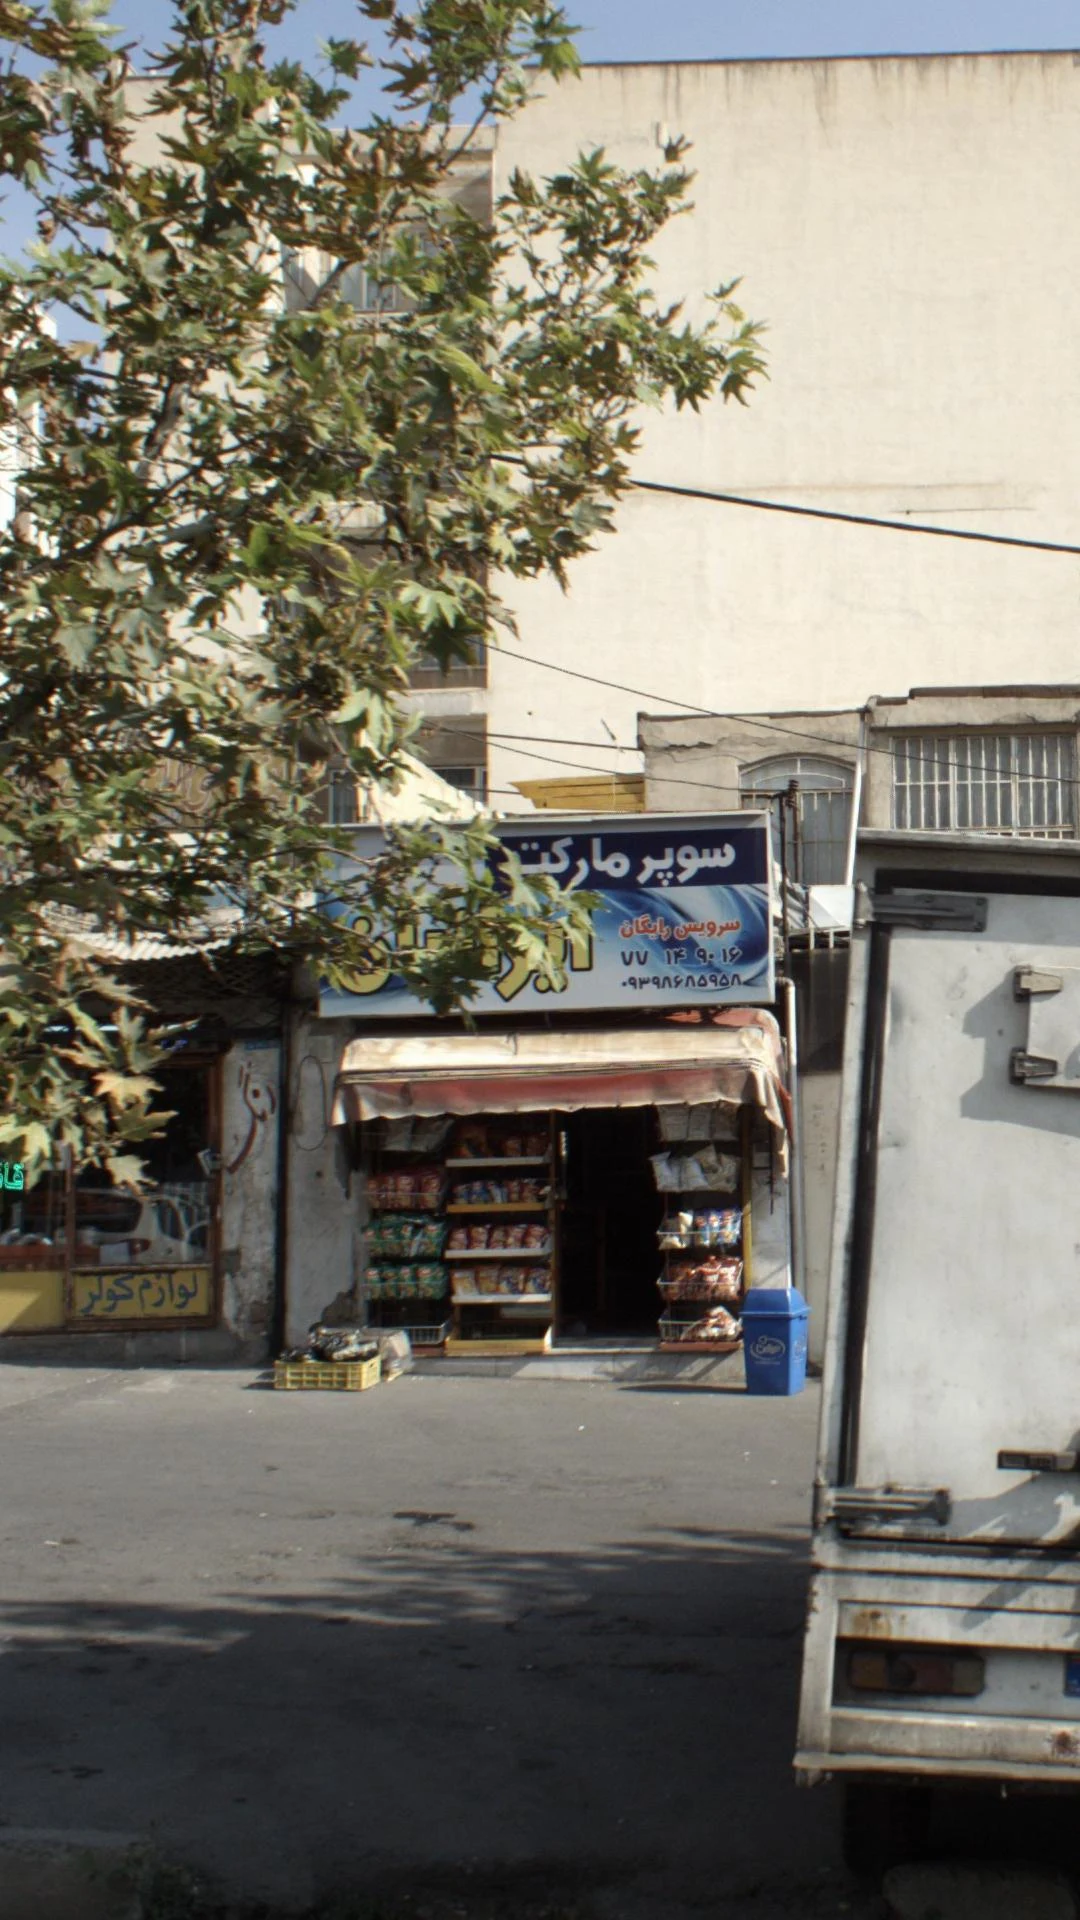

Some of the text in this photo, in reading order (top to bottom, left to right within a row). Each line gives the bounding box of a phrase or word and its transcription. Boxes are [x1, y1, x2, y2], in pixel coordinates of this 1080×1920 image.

[513, 836, 735, 891] سوپر مارکت
[620, 914, 741, 940] سرویس رایگان
[79, 1272, 198, 1314] لوازم کولر
